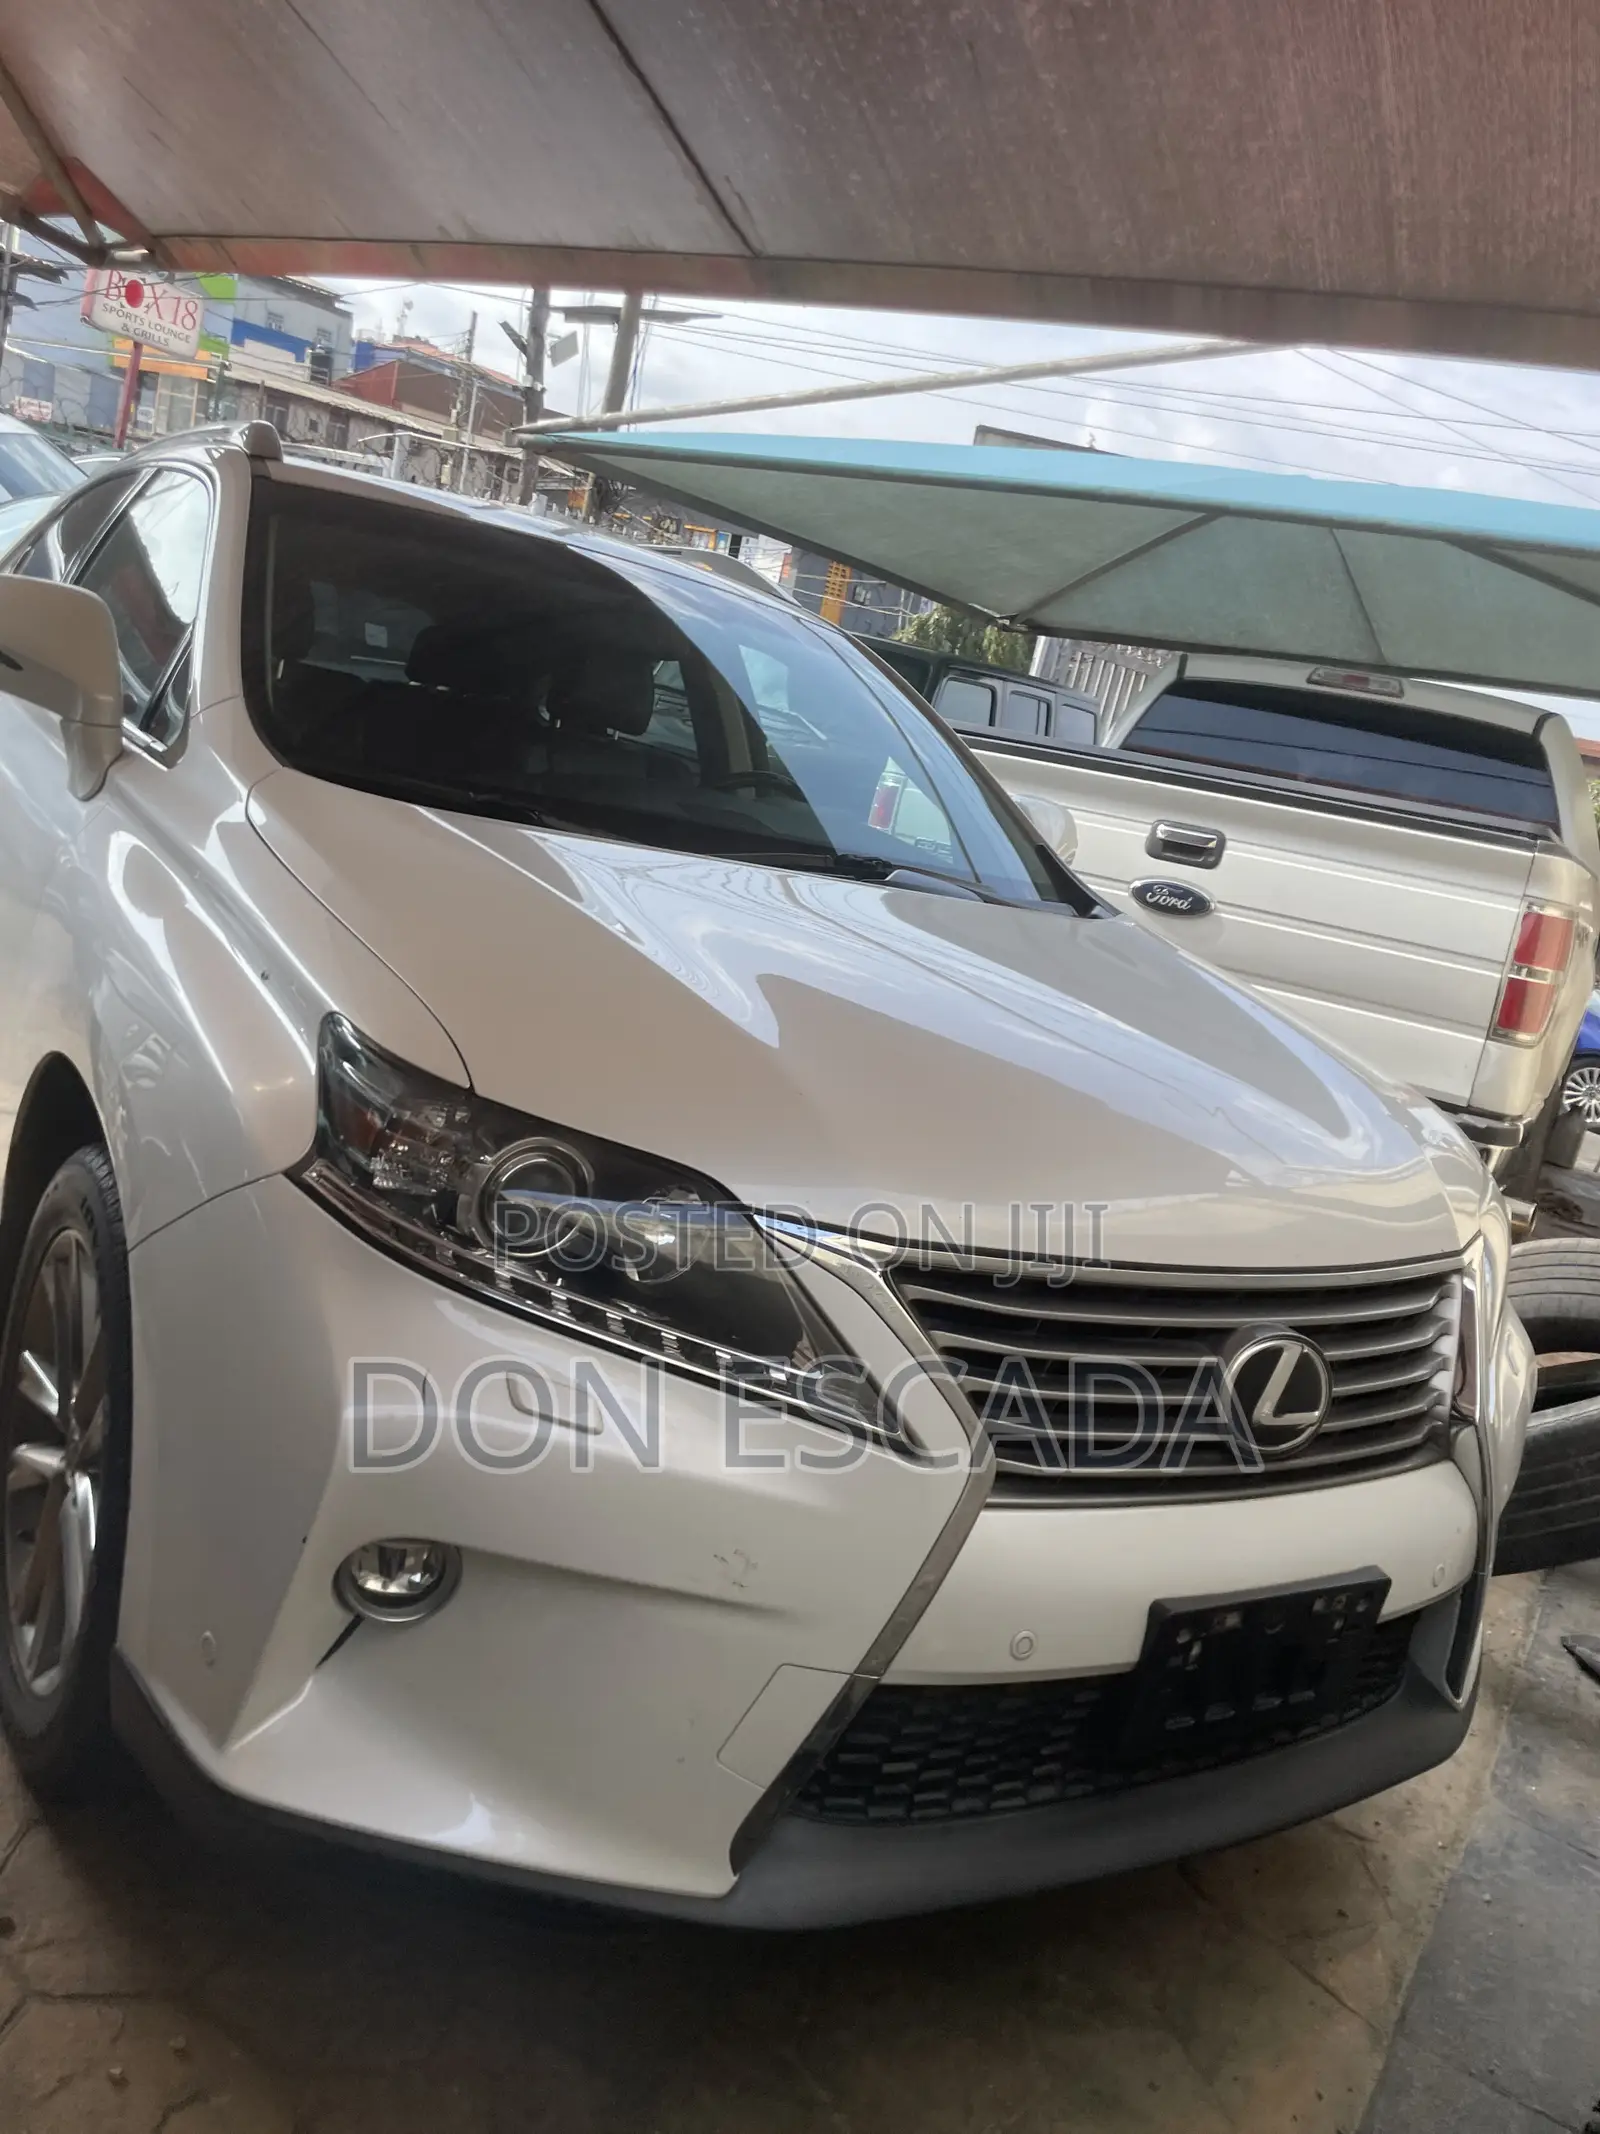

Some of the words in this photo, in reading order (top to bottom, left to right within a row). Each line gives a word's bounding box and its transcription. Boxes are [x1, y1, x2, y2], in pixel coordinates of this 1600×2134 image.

[102, 302, 146, 326] SPORTS
[147, 318, 193, 344] LOUNGE
[121, 322, 131, 333] &
[132, 326, 171, 347] GRILLS
[1146, 884, 1193, 910] Ford
